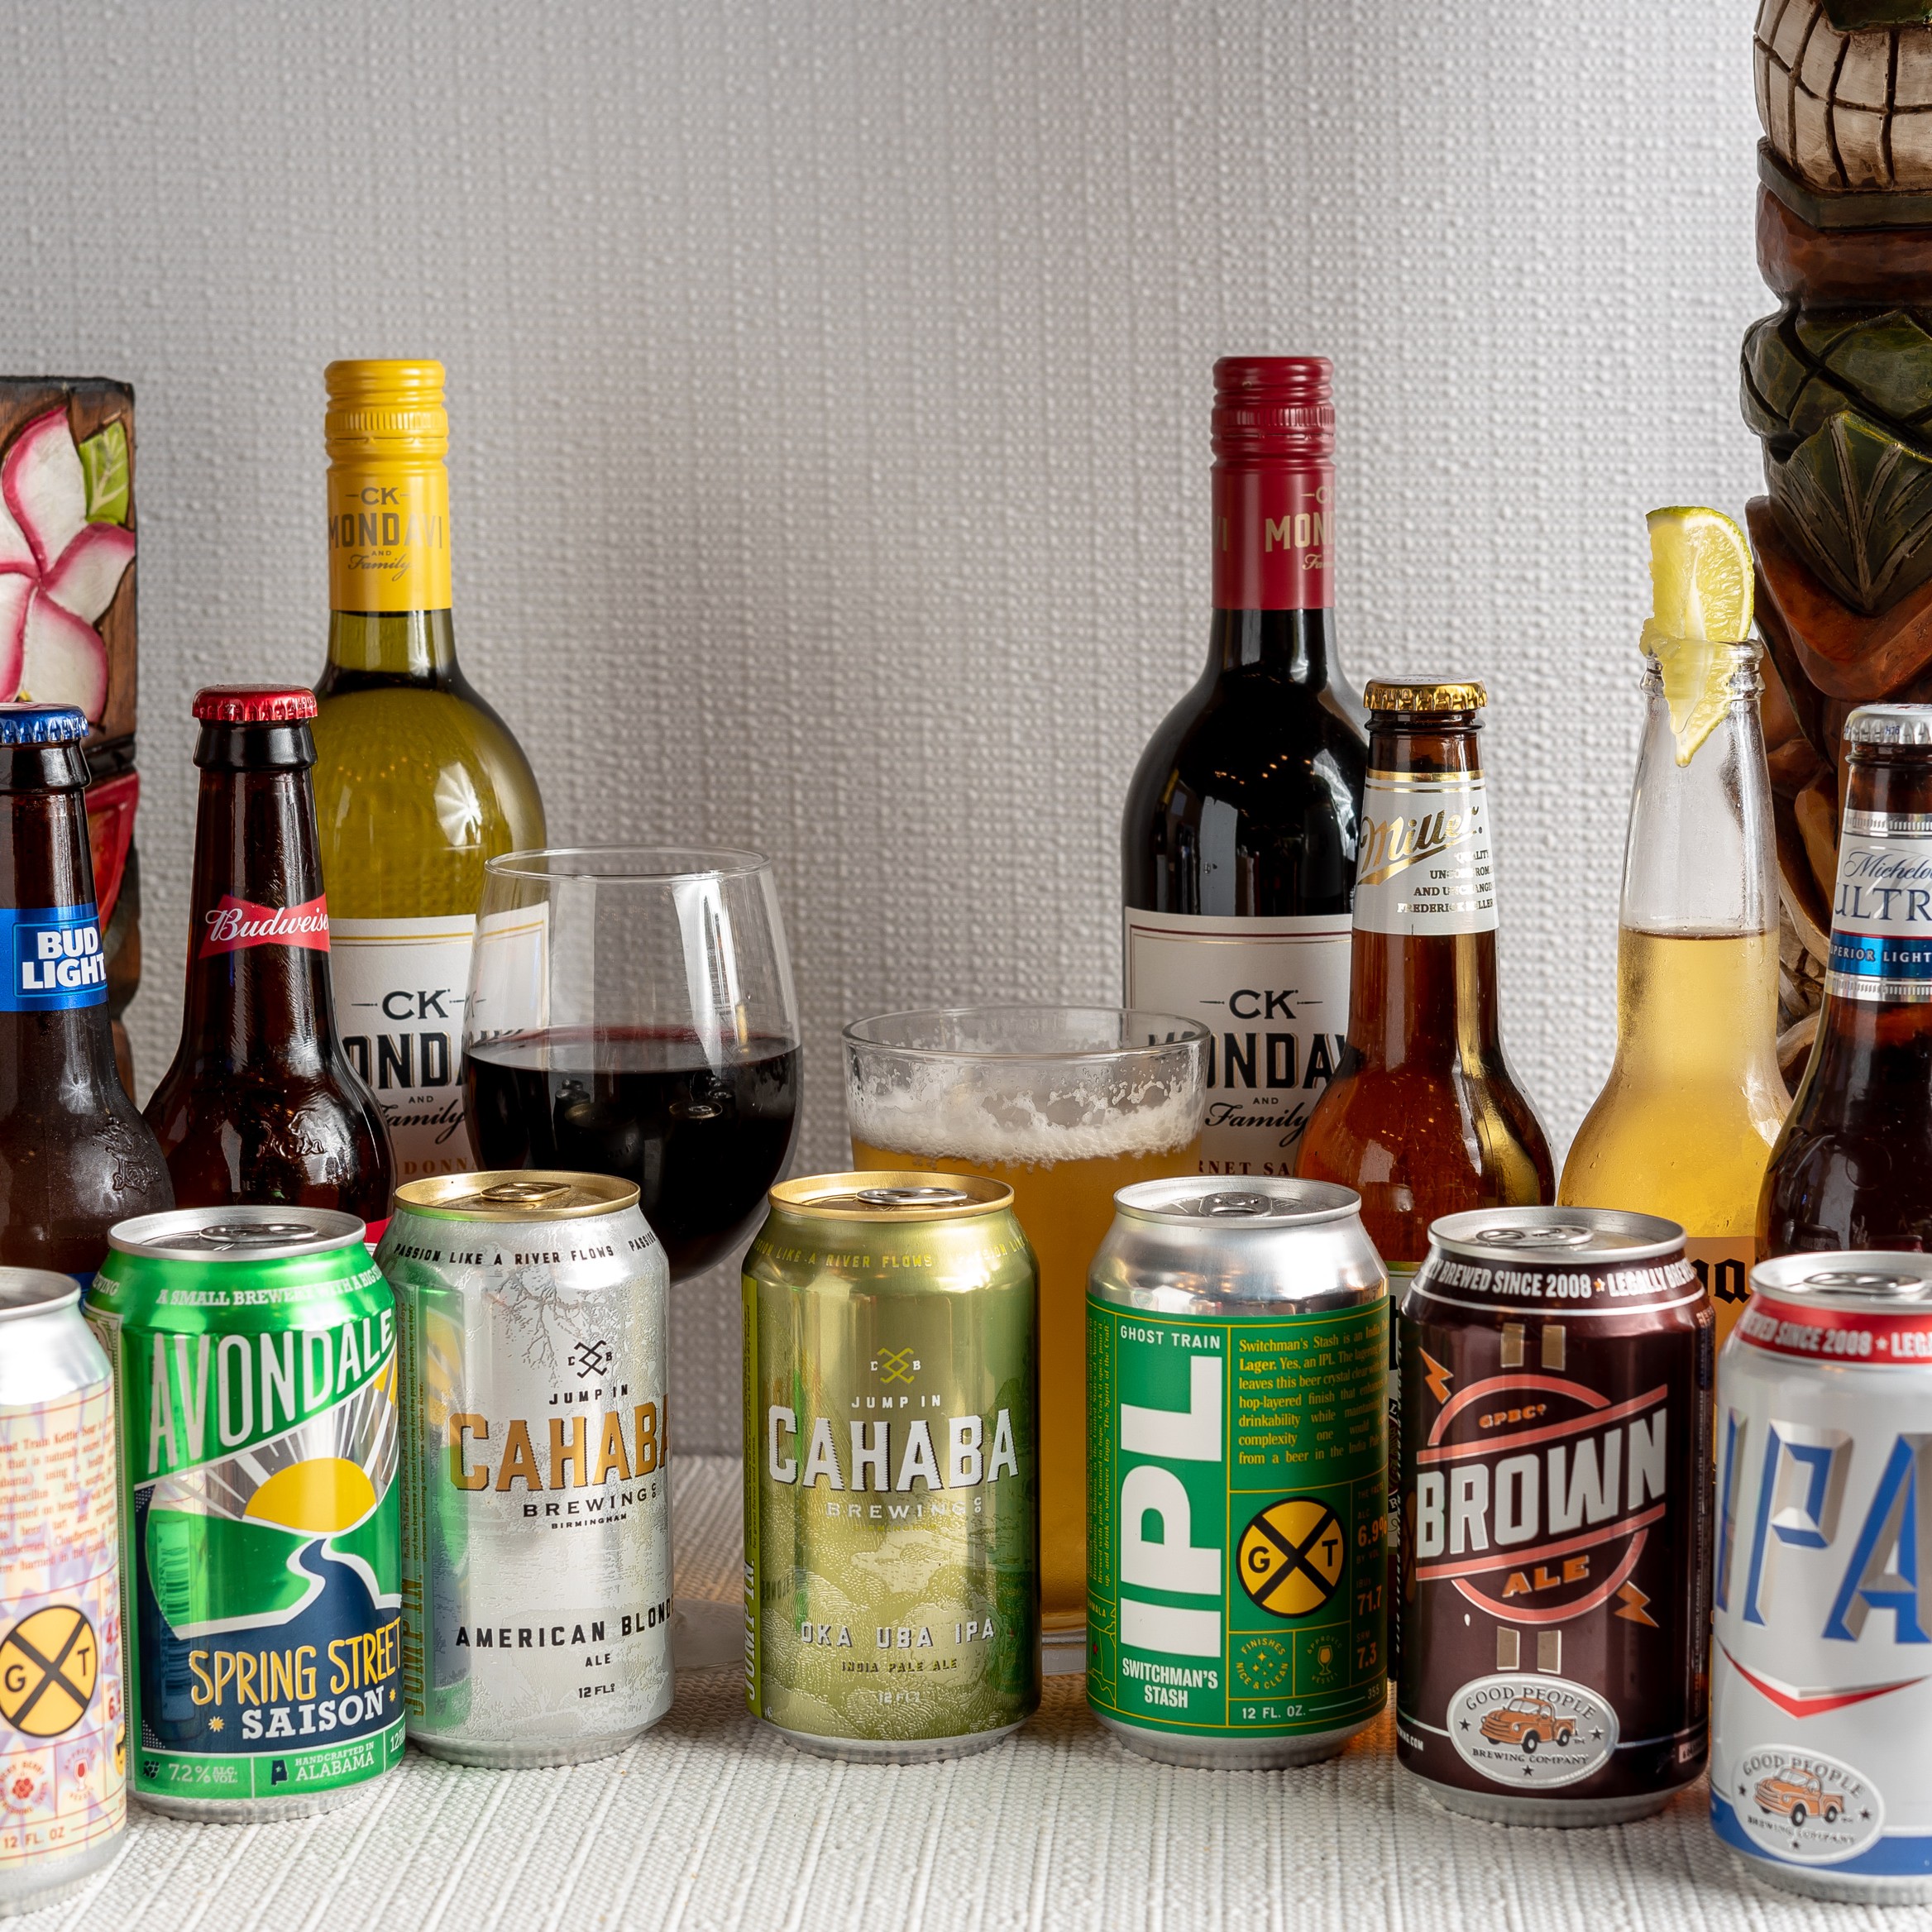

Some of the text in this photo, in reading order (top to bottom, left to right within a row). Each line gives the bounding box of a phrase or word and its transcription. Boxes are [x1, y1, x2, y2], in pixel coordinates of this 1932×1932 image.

[361, 487, 399, 505] CK
[328, 513, 442, 549] MONDAVI
[348, 554, 410, 581] Family
[1360, 806, 1480, 874] Miller
[1844, 851, 1932, 879] Michelo
[1413, 887, 1440, 897] AND
[1835, 882, 1932, 921] ULTR
[205, 907, 329, 941] Budweise
[37, 926, 98, 959] BUD
[1883, 952, 1931, 963] LIGHT
[22, 959, 105, 989] LIGHT
[382, 990, 449, 1020] CK
[1229, 989, 1298, 1020] CK
[342, 1031, 466, 1089] OND
[1204, 1102, 1311, 1147] Family
[393, 1243, 442, 1263] PASSION
[449, 1251, 483, 1265] LIKE
[494, 1254, 503, 1265] A
[514, 1252, 561, 1265] RIVER
[571, 1246, 615, 1262] FLOWS
[776, 1247, 802, 1263] LIKE
[825, 1254, 871, 1267] RIVER
[882, 1254, 933, 1268] FLOWS
[1438, 1261, 1493, 1292] BREWED
[1492, 1270, 1543, 1297] SINCE
[1546, 1274, 1593, 1298] 2008
[1607, 1266, 1667, 1297] LEGALLY
[156, 1289, 170, 1304] A
[171, 1288, 231, 1306] SMALL
[1121, 1325, 1222, 1350] GHOST TRAIN
[1239, 1337, 1308, 1352] Switchman's
[1313, 1334, 1339, 1348] Stash
[1343, 1332, 1350, 1344] is
[1354, 1332, 1363, 1341] an
[1775, 1321, 1872, 1356] SINCE 2008
[1239, 1358, 1277, 1374] Lager.
[1279, 1356, 1301, 1370] Yes,
[1303, 1357, 1316, 1368] an
[1338, 1351, 1353, 1363] The
[147, 1308, 393, 1475] AVONDALE
[1239, 1369, 1350, 1389] leaves this beer crystal
[549, 1384, 629, 1405] JUMP IN
[851, 1394, 941, 1408] JUMP IN
[1239, 1388, 1355, 1411] hop-layered finish that
[1239, 1409, 1336, 1428] drinkability while
[768, 1404, 1020, 1492] CAHABA
[1238, 1432, 1297, 1448] complexity
[1317, 1430, 1334, 1442] one
[1238, 1451, 1265, 1464] from
[1272, 1454, 1279, 1464] a
[1286, 1451, 1309, 1463] beer
[1315, 1448, 1324, 1461] in
[1331, 1445, 1344, 1458] the
[1417, 1408, 1667, 1559] BROWN
[523, 1489, 648, 1518] BREWING
[827, 1500, 966, 1520] BREWING
[1121, 1356, 1222, 1657] IPL
[552, 1513, 628, 1529] BIRMINGHAM
[1357, 1514, 1388, 1547] 6.9%
[1715, 1407, 1932, 1645] IPA
[1247, 1546, 1270, 1574] G
[1322, 1538, 1338, 1567] T
[1502, 1555, 1590, 1598] ALE
[1357, 1585, 1382, 1616] 71.7
[456, 1594, 674, 1648] AMERICAN BLOND
[801, 1619, 995, 1649] OKA UBA IPA
[189, 1616, 401, 1706] SPRING STREET
[585, 1653, 611, 1667] ALE
[745, 1601, 755, 1700] JUMP
[1241, 1637, 1286, 1656] FINISHES
[1357, 1642, 1378, 1670] 7.3
[77, 1647, 90, 1676] T
[402, 1619, 425, 1717] JUMP
[842, 1658, 958, 1672] INDIA PALE ALE
[1122, 1657, 1218, 1689] SWITCHMAN'S
[1236, 1662, 1289, 1690] NICE CLEAN
[5, 1664, 26, 1694] G
[578, 1687, 591, 1699] 12
[1145, 1685, 1188, 1709] STASH
[1242, 1684, 1380, 1719] 12 FL. OZ. 355
[1466, 1686, 1597, 1720] GOOD PEOPLE
[242, 1686, 384, 1739] SAISON
[294, 1741, 374, 1767] HANDCRAFTED IN
[390, 1732, 399, 1753] 12
[1472, 1747, 1590, 1765] BREWING COMPANY
[213, 1767, 237, 1775] ALC.
[213, 1774, 238, 1784] VOL.
[294, 1752, 374, 1782] ALABAMA
[1743, 1754, 1865, 1800] GOOD PEOPLE
[4, 1836, 17, 1848] 12
[50, 1826, 65, 1840] OZ
